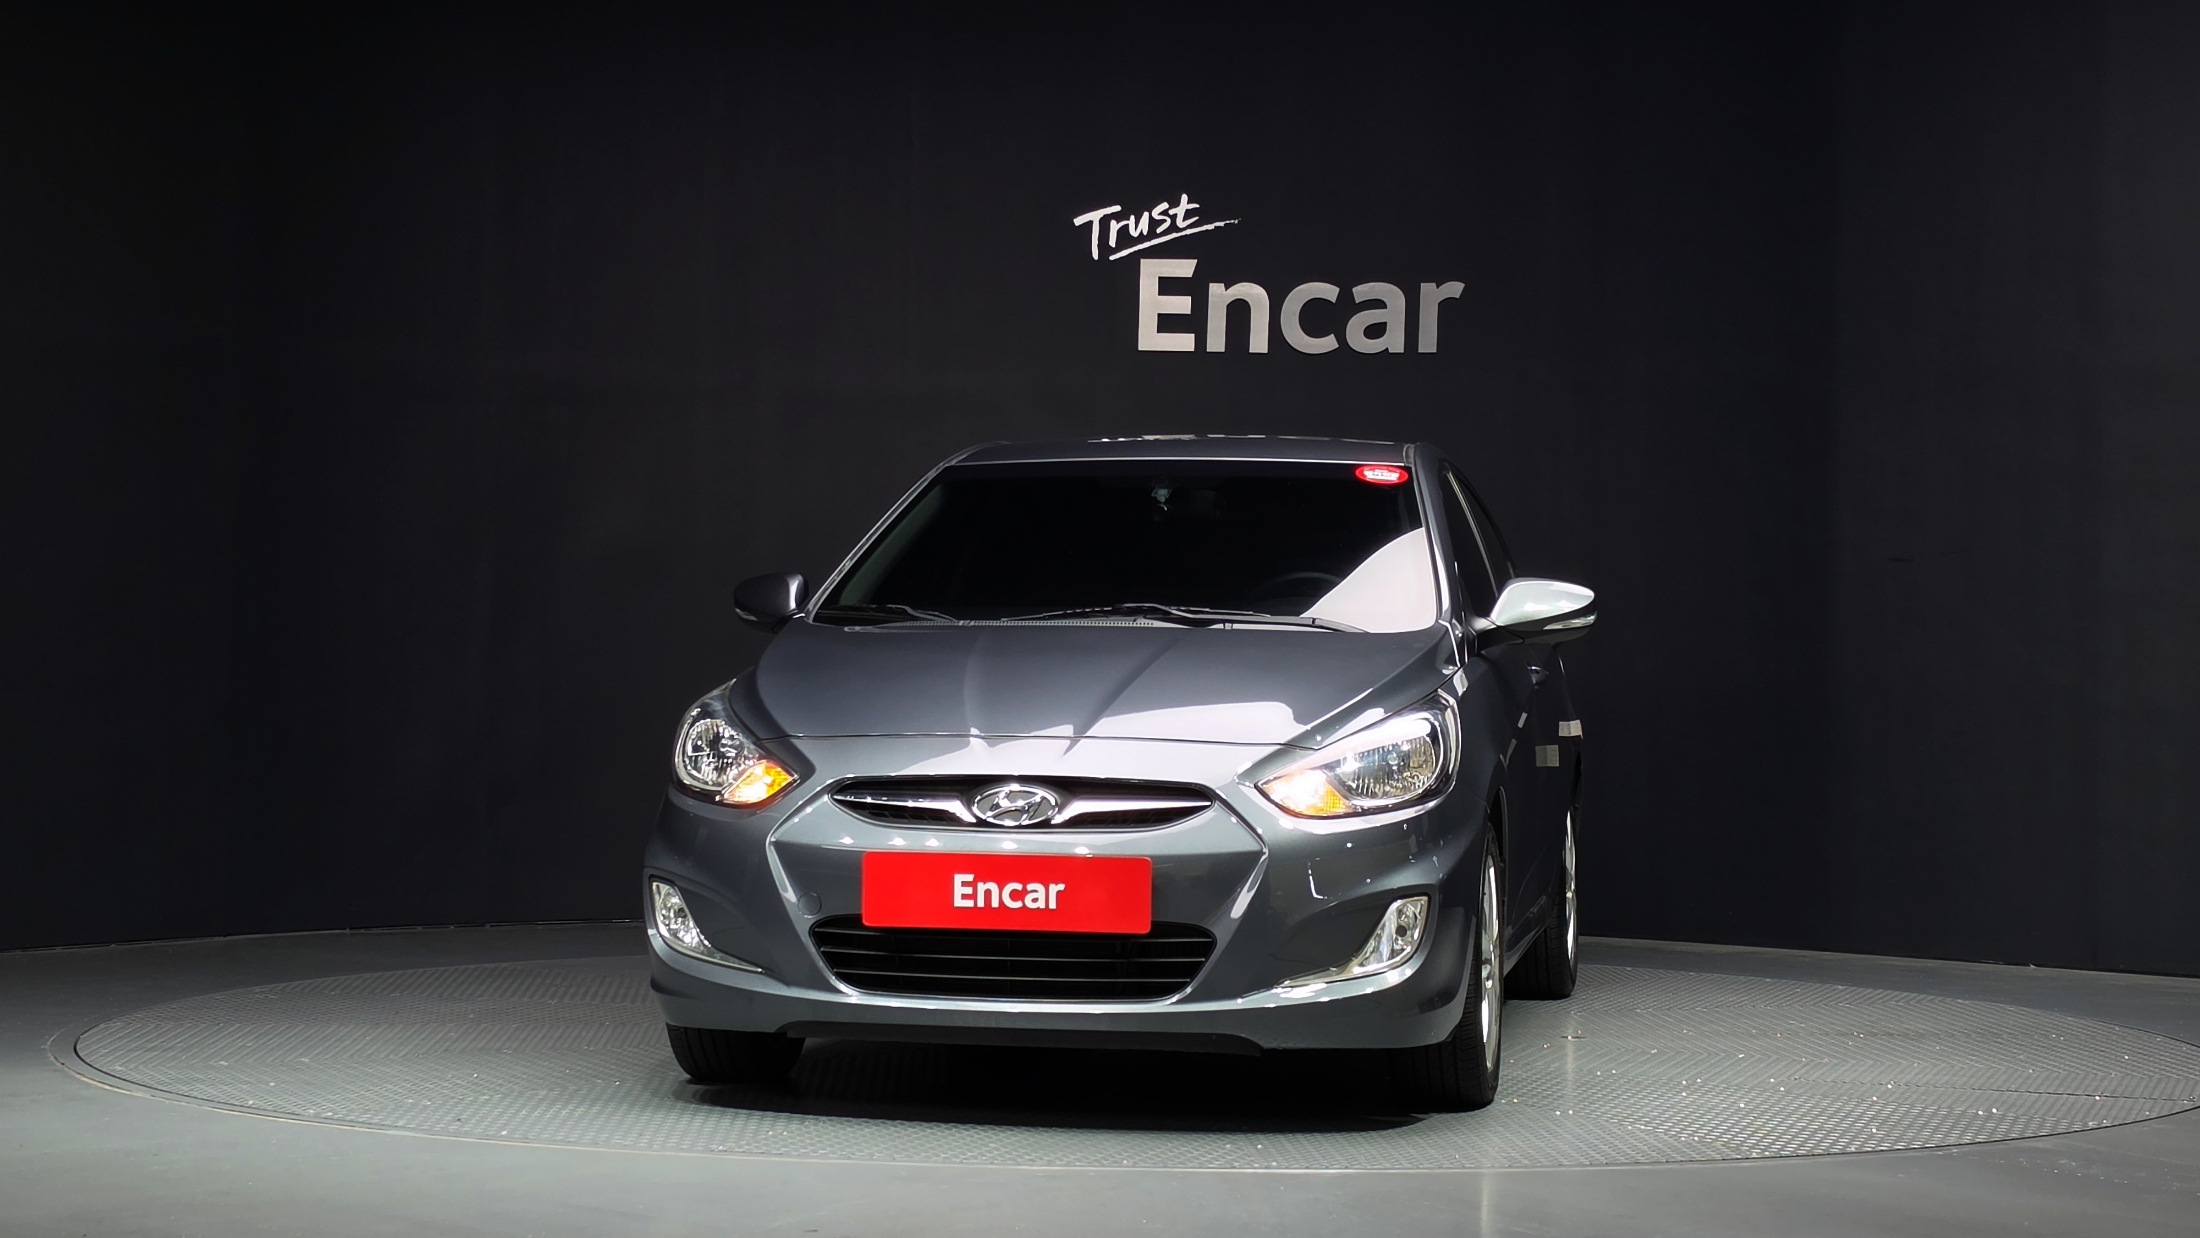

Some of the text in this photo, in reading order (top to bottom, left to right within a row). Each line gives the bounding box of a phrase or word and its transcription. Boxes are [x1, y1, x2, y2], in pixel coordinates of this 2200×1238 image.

[1073, 193, 1200, 261] Trust
[1137, 258, 1466, 354] Encar
[953, 873, 1066, 910] Encar
